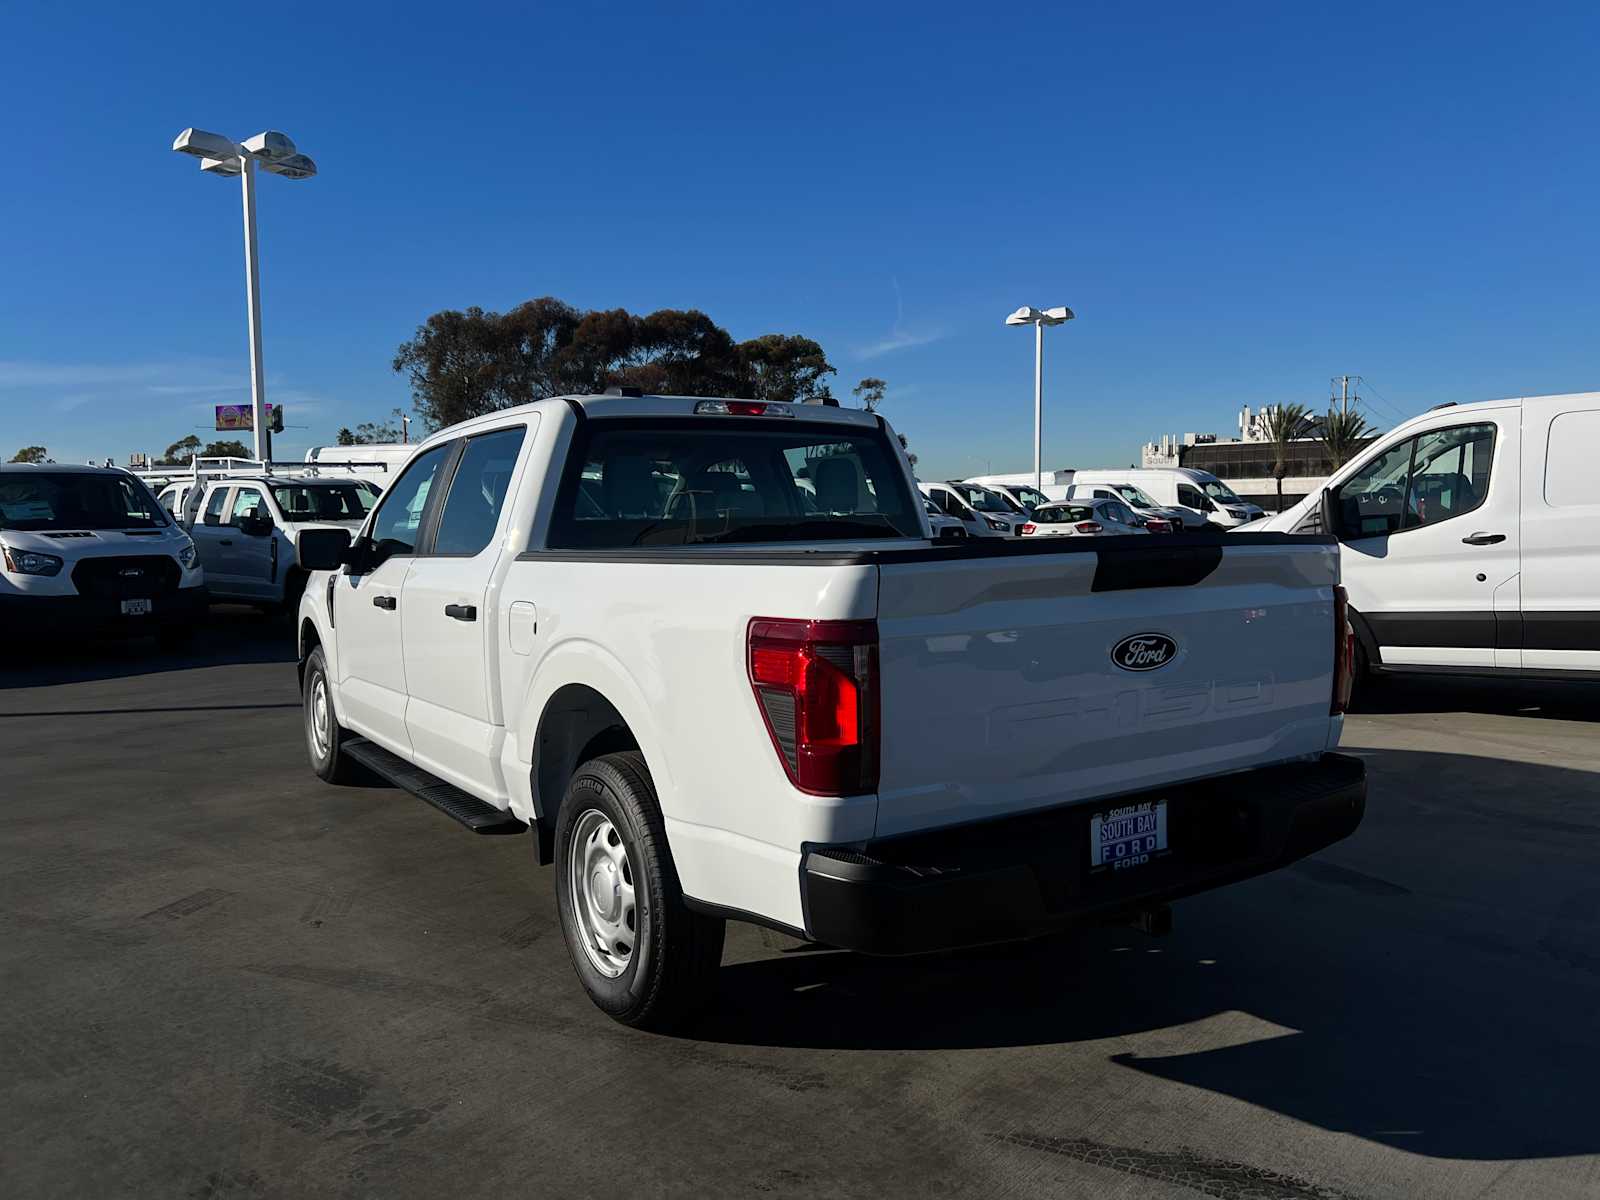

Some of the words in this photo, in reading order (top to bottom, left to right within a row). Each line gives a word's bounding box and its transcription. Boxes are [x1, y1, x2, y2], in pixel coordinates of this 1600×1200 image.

[1124, 640, 1167, 664] Ford
[985, 674, 1278, 745] F-150
[1109, 806, 1135, 817] SOUTH
[1138, 801, 1152, 812] BAY
[1101, 819, 1134, 841] SOUTH
[1137, 814, 1156, 832] BAY
[1102, 837, 1156, 862] FORD
[1114, 854, 1149, 871] FORD
